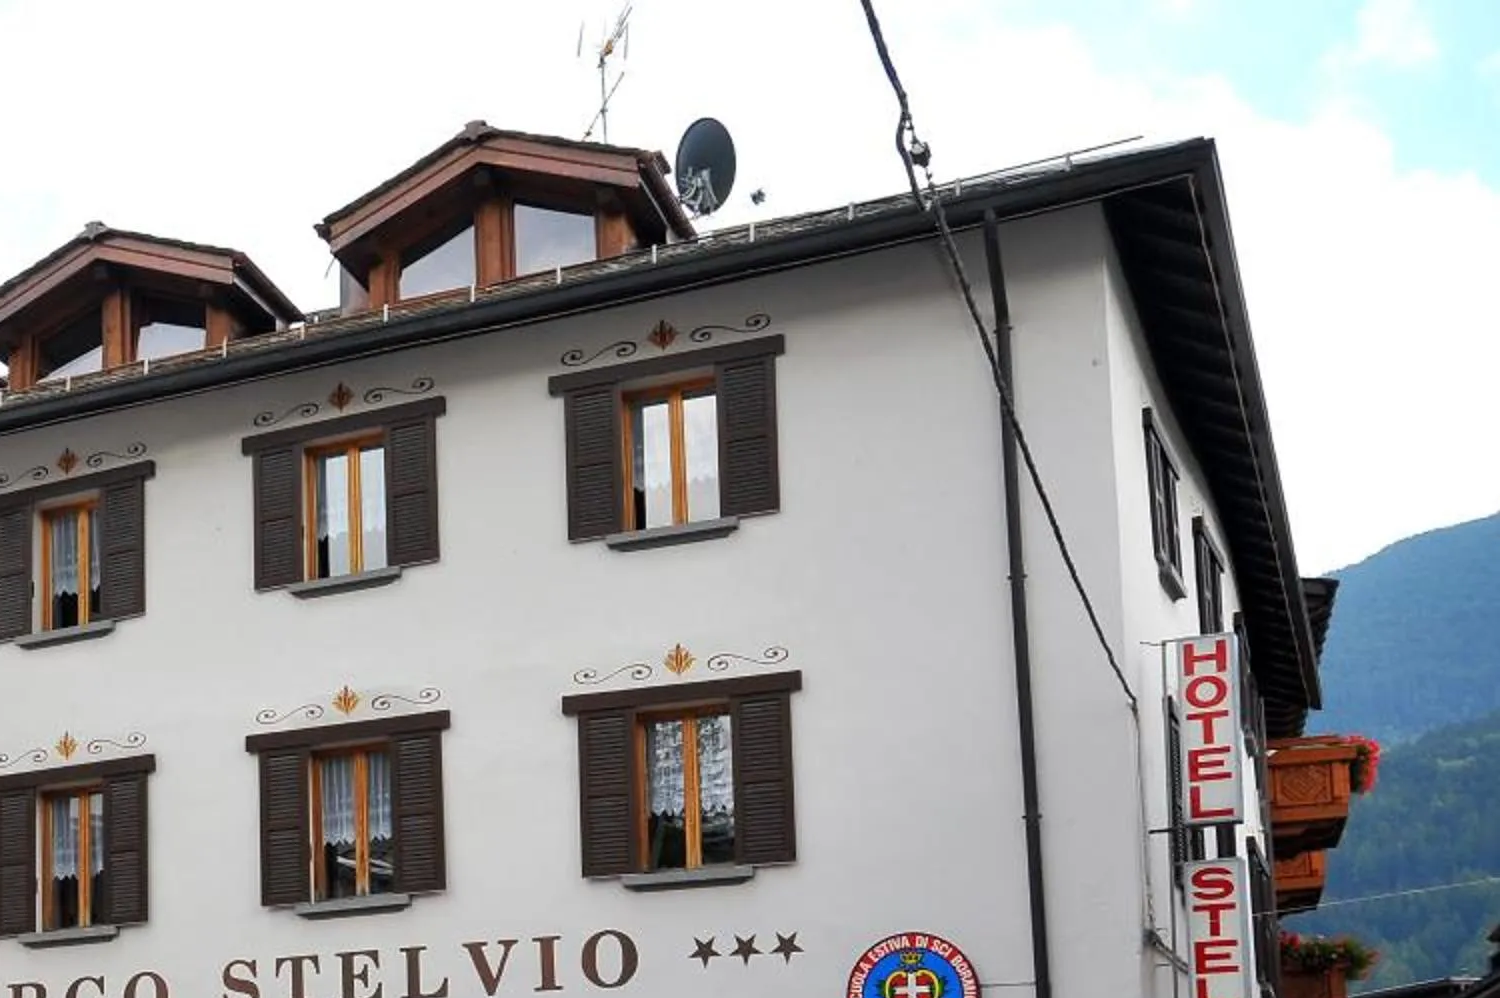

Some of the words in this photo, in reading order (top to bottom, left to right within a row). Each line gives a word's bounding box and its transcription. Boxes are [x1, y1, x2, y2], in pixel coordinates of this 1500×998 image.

[1183, 640, 1234, 820] HOTEL
[867, 935, 911, 963] ESTIVA
[915, 935, 929, 948] DI
[931, 939, 953, 957] SCI
